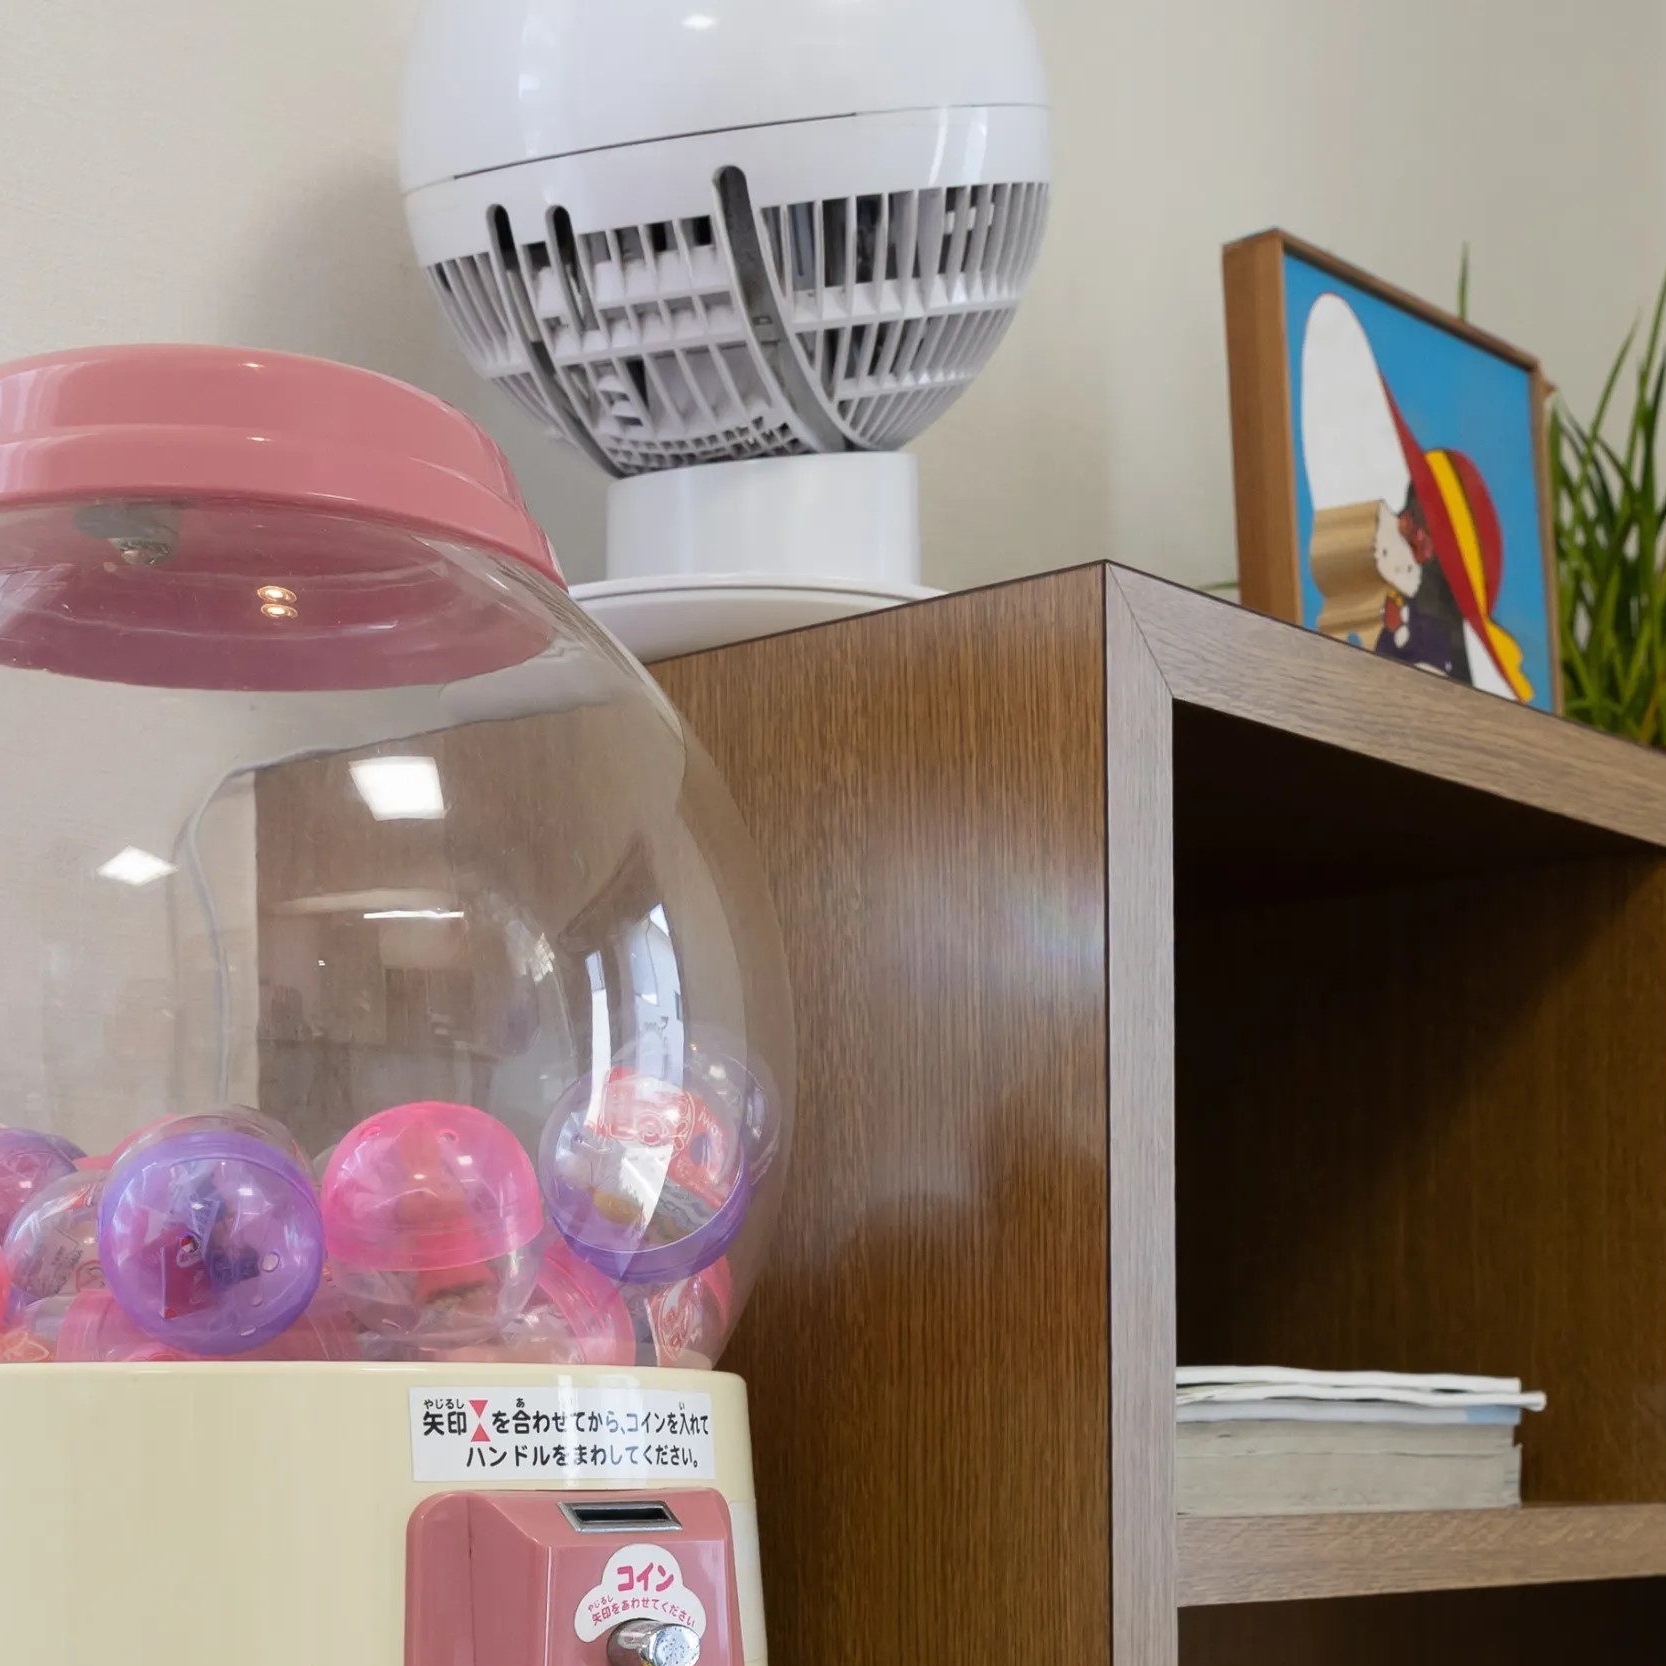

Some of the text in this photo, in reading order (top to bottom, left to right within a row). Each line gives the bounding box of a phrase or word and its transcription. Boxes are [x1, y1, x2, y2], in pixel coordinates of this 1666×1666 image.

[424, 1398, 465, 1410] やじるし
[466, 1444, 698, 1468] ハンドルをまわしてください。
[617, 1562, 674, 1592] コイン
[591, 1596, 695, 1627] 矢印をあわせてください
